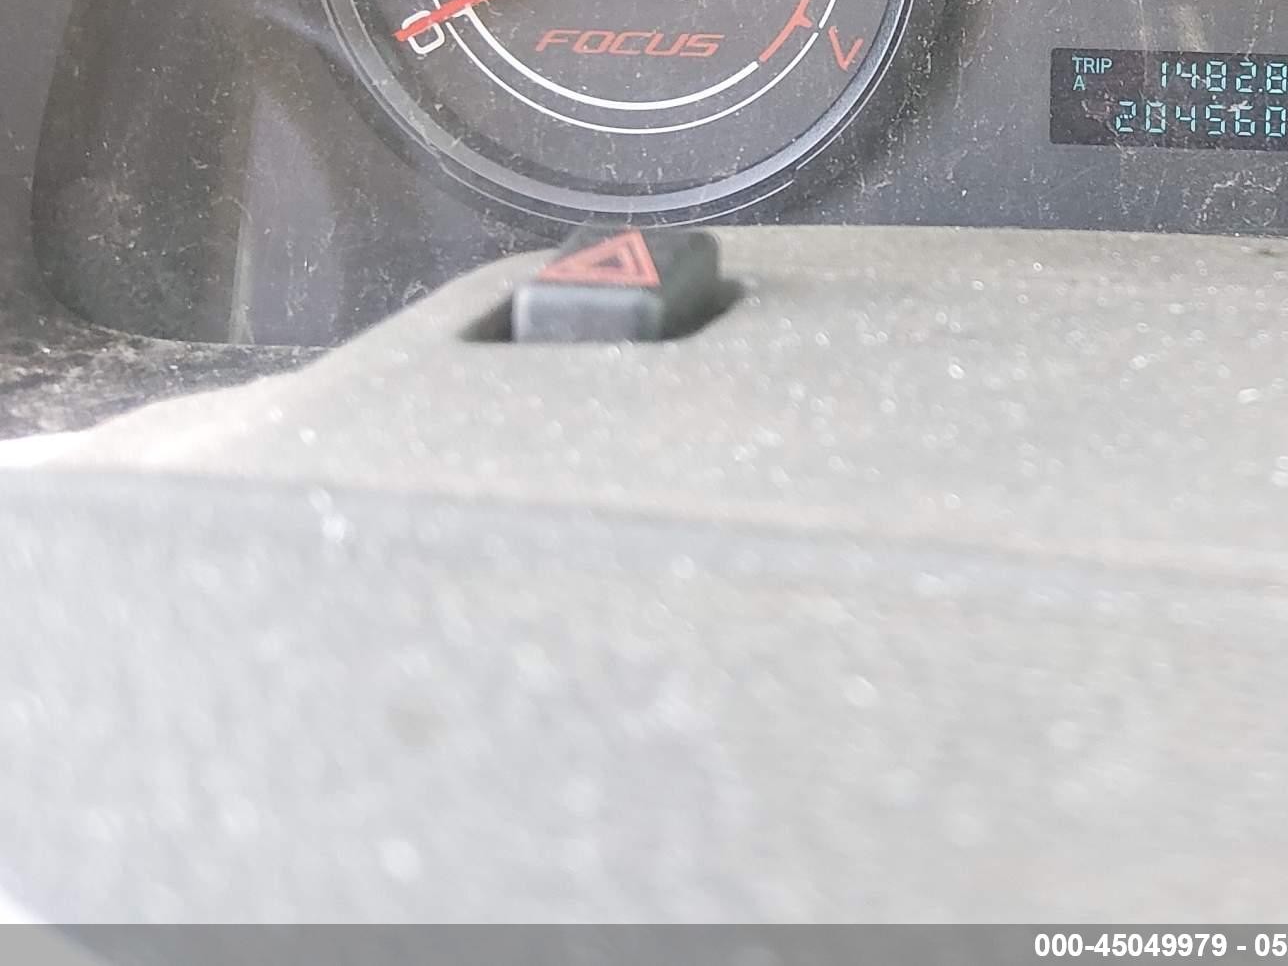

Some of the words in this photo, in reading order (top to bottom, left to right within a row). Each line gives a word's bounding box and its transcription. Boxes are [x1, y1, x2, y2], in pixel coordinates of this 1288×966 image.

[400, 9, 446, 55] 0
[535, 29, 725, 57] FOCUS
[828, 27, 864, 70] 7
[1072, 57, 1113, 75] TRIP
[1072, 75, 1086, 91] A
[1115, 100, 1288, 138] 204560
